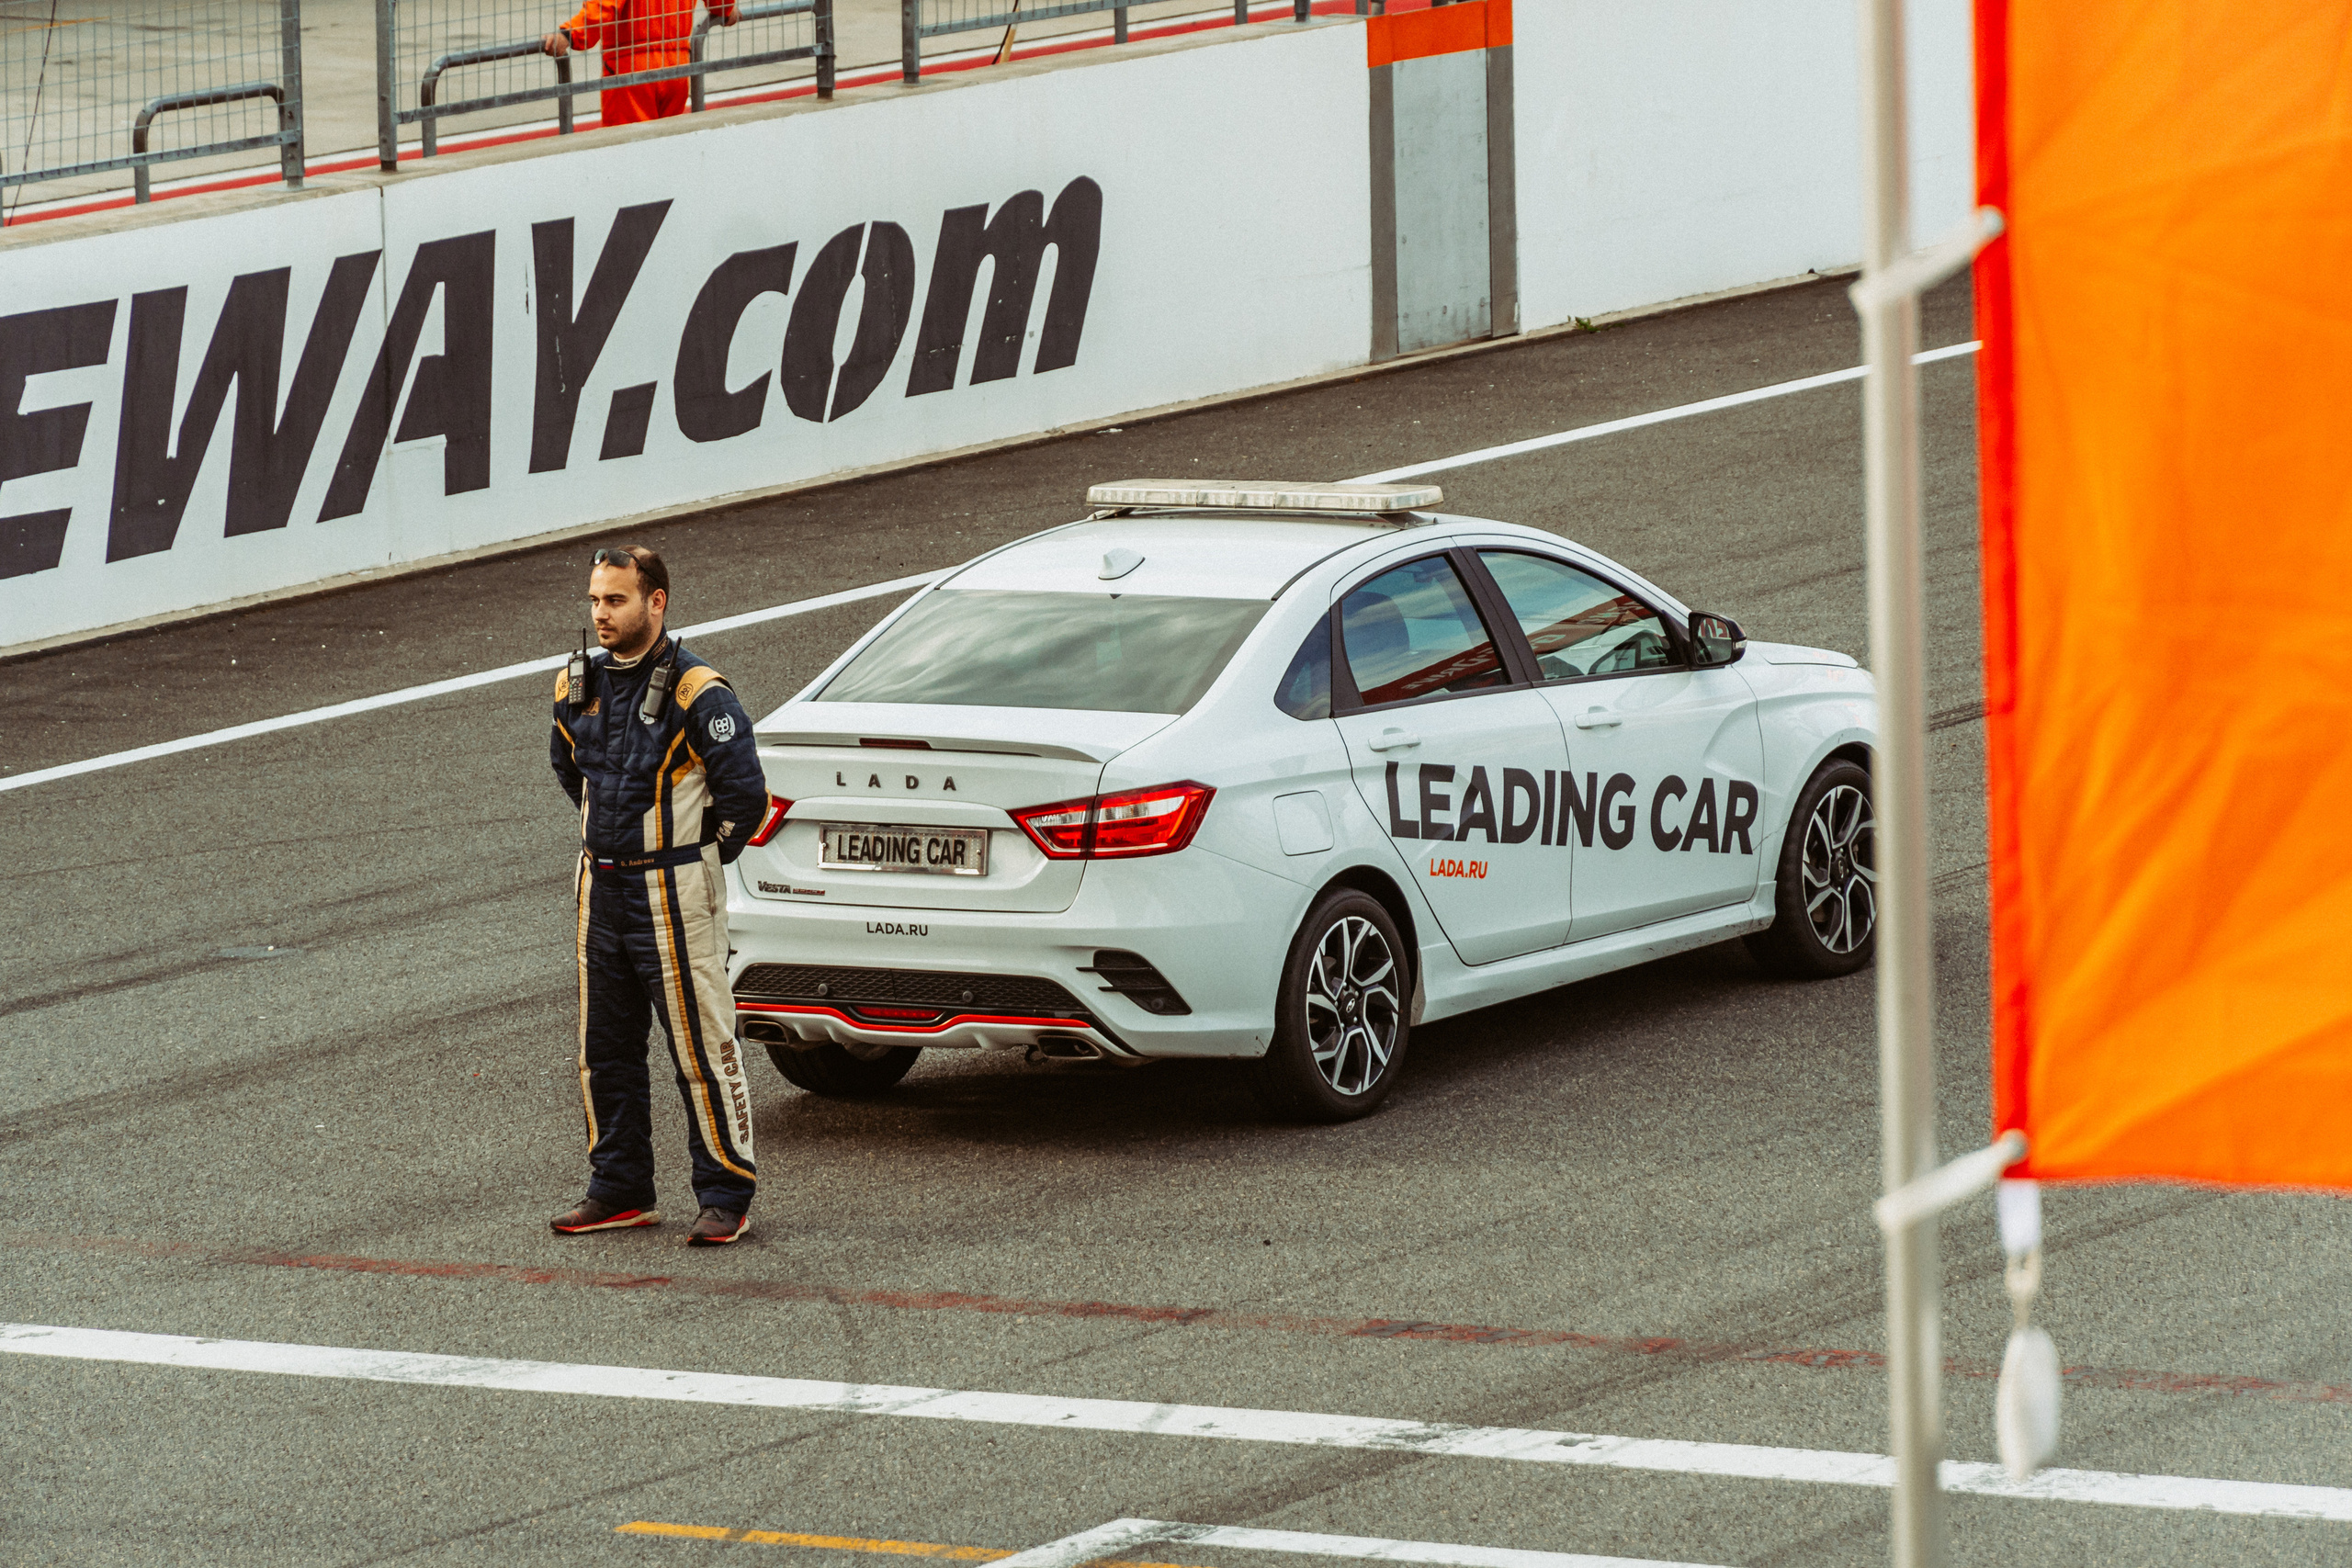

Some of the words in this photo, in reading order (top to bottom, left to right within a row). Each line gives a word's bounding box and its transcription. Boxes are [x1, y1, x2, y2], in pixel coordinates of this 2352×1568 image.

[836, 771, 957, 792] LADA
[1385, 761, 1636, 852] LEADING
[1650, 774, 1759, 855] CAR
[837, 834, 920, 863] LEADING
[926, 838, 966, 865] CAR
[1430, 858, 1488, 879] LADA.RU
[866, 921, 929, 936] LADA.RU
[719, 1038, 740, 1077] CAR
[729, 1081, 750, 1145] SAFETY
